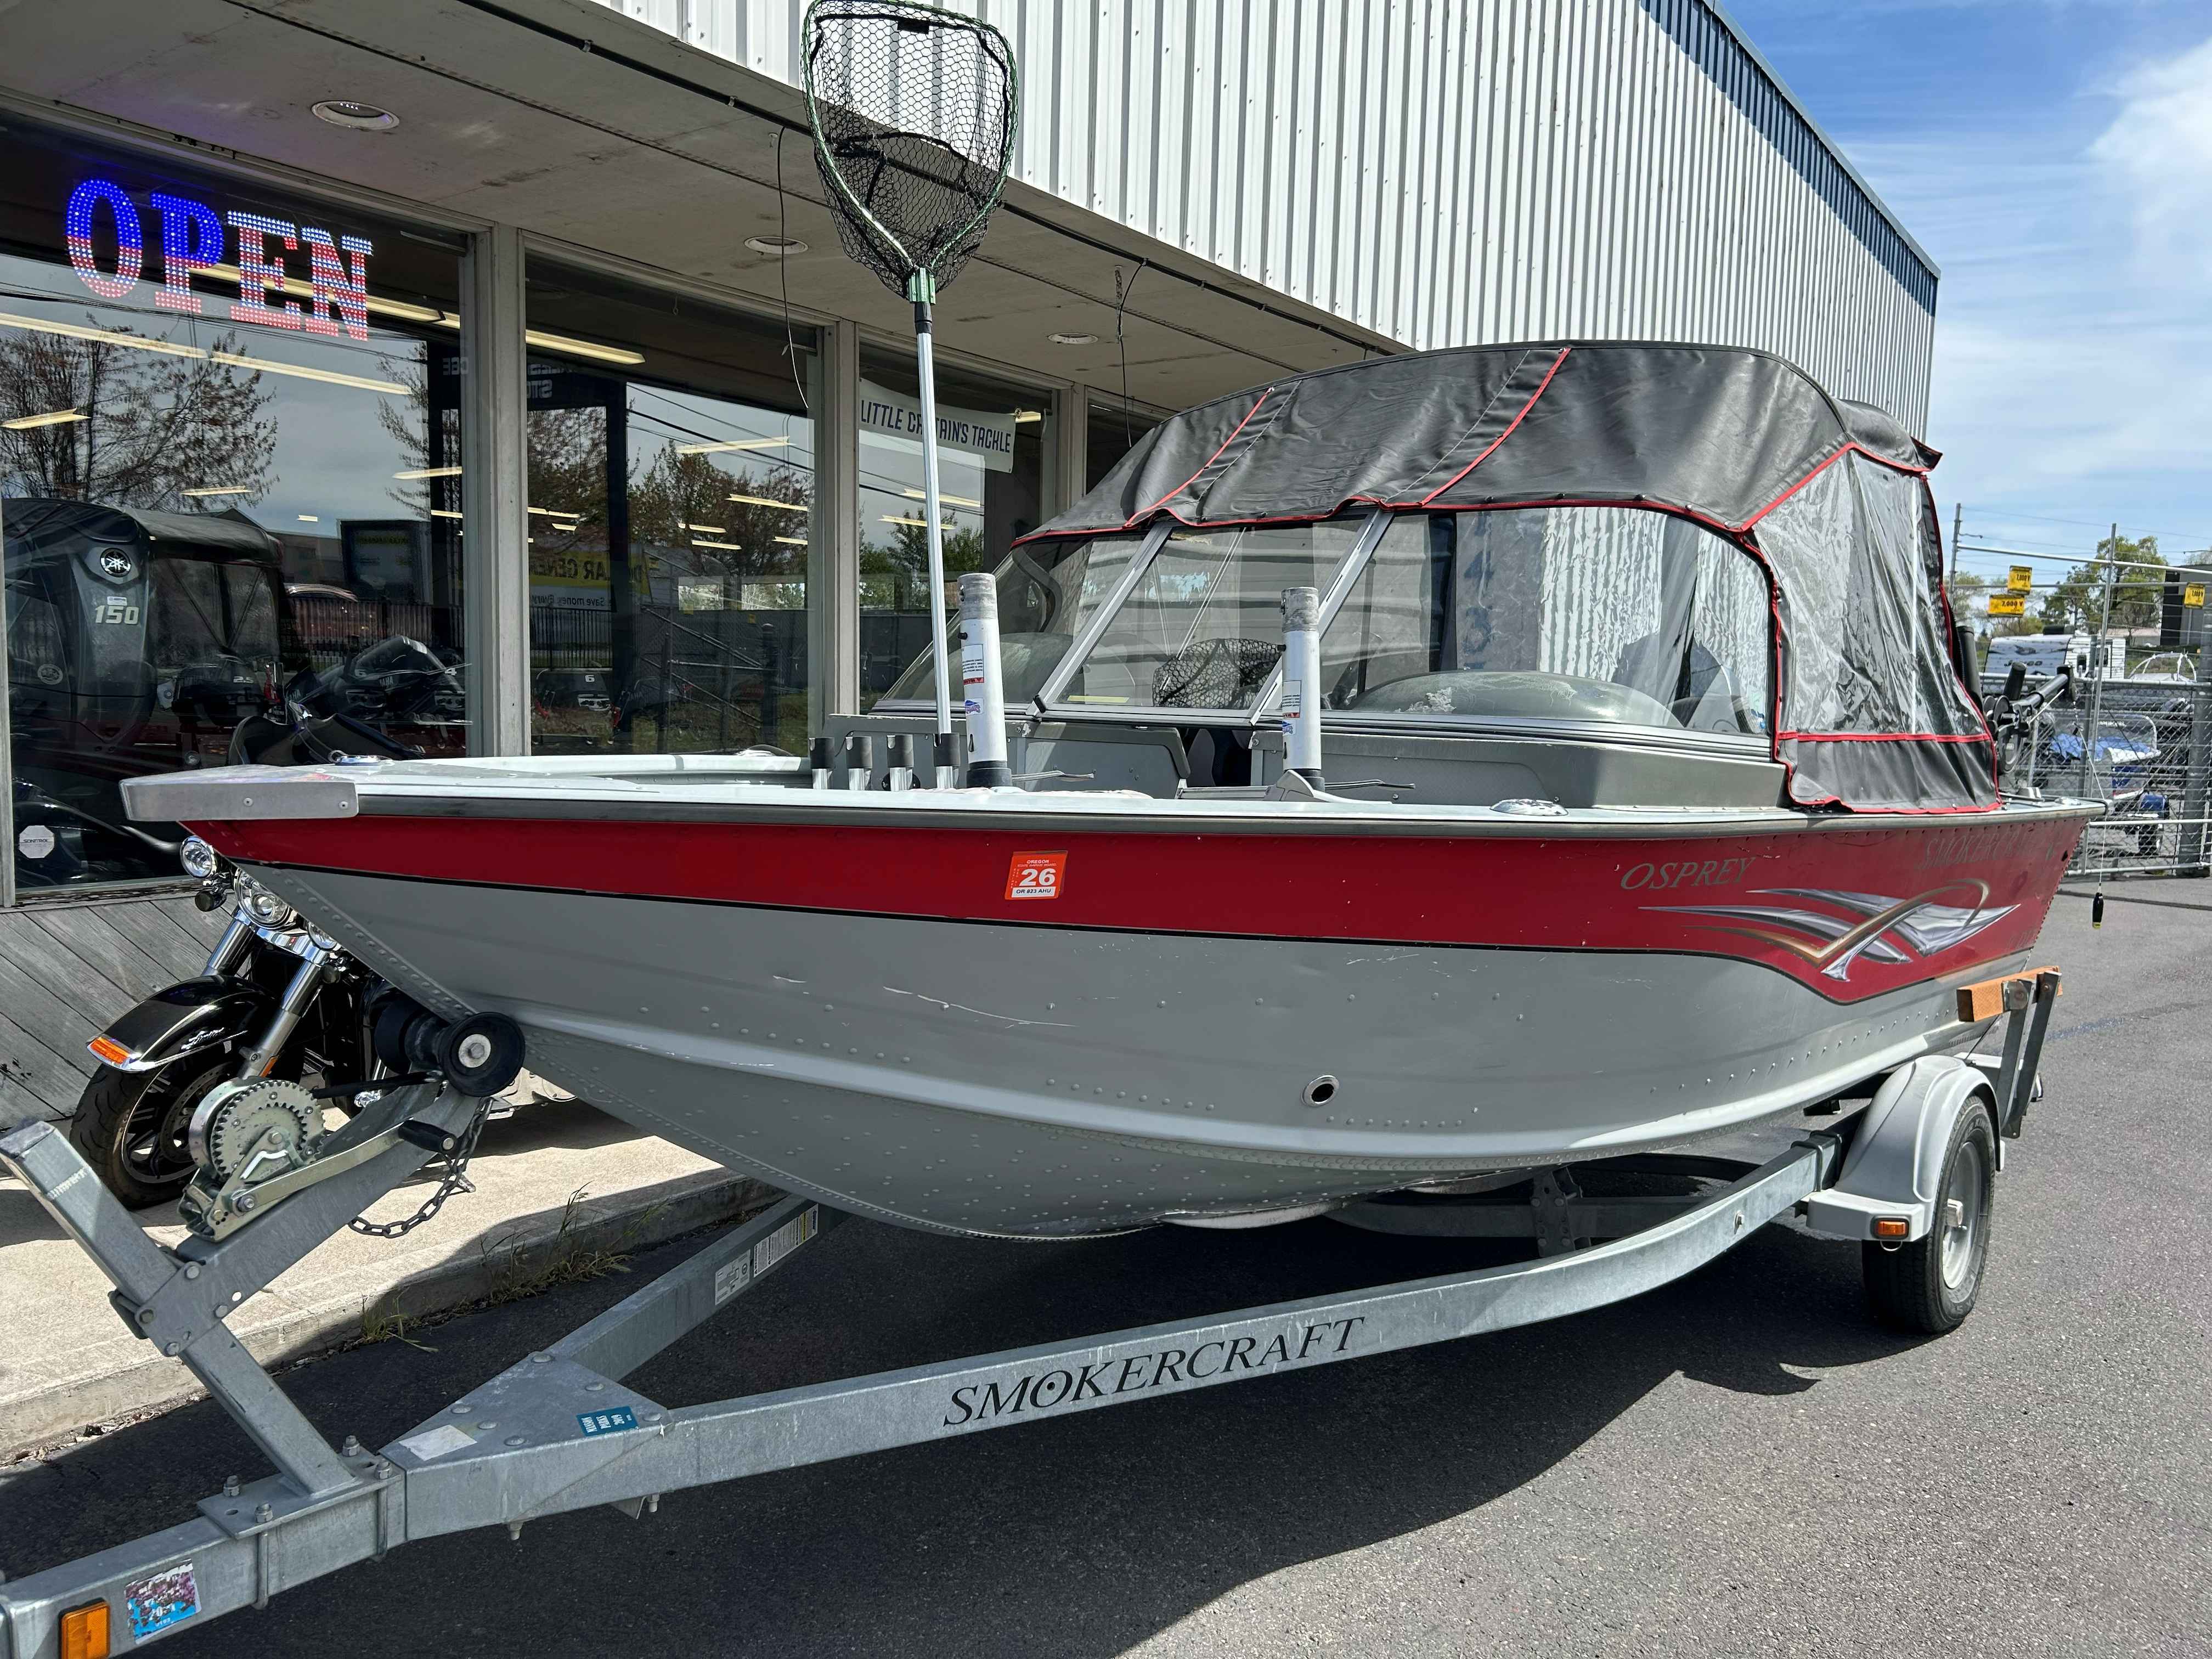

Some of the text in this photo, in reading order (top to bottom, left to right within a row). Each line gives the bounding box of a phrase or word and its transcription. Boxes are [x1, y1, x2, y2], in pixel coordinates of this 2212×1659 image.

[65, 178, 374, 341] OPEN
[861, 400, 1011, 453] LITTLE CATAIN'S TACKLE
[95, 605, 139, 624] 150
[233, 675, 253, 684] 2.5
[1019, 868, 1057, 887] 26
[1620, 856, 1757, 891] OSPREY
[942, 1316, 1366, 1428] SMOKERCRAFT
